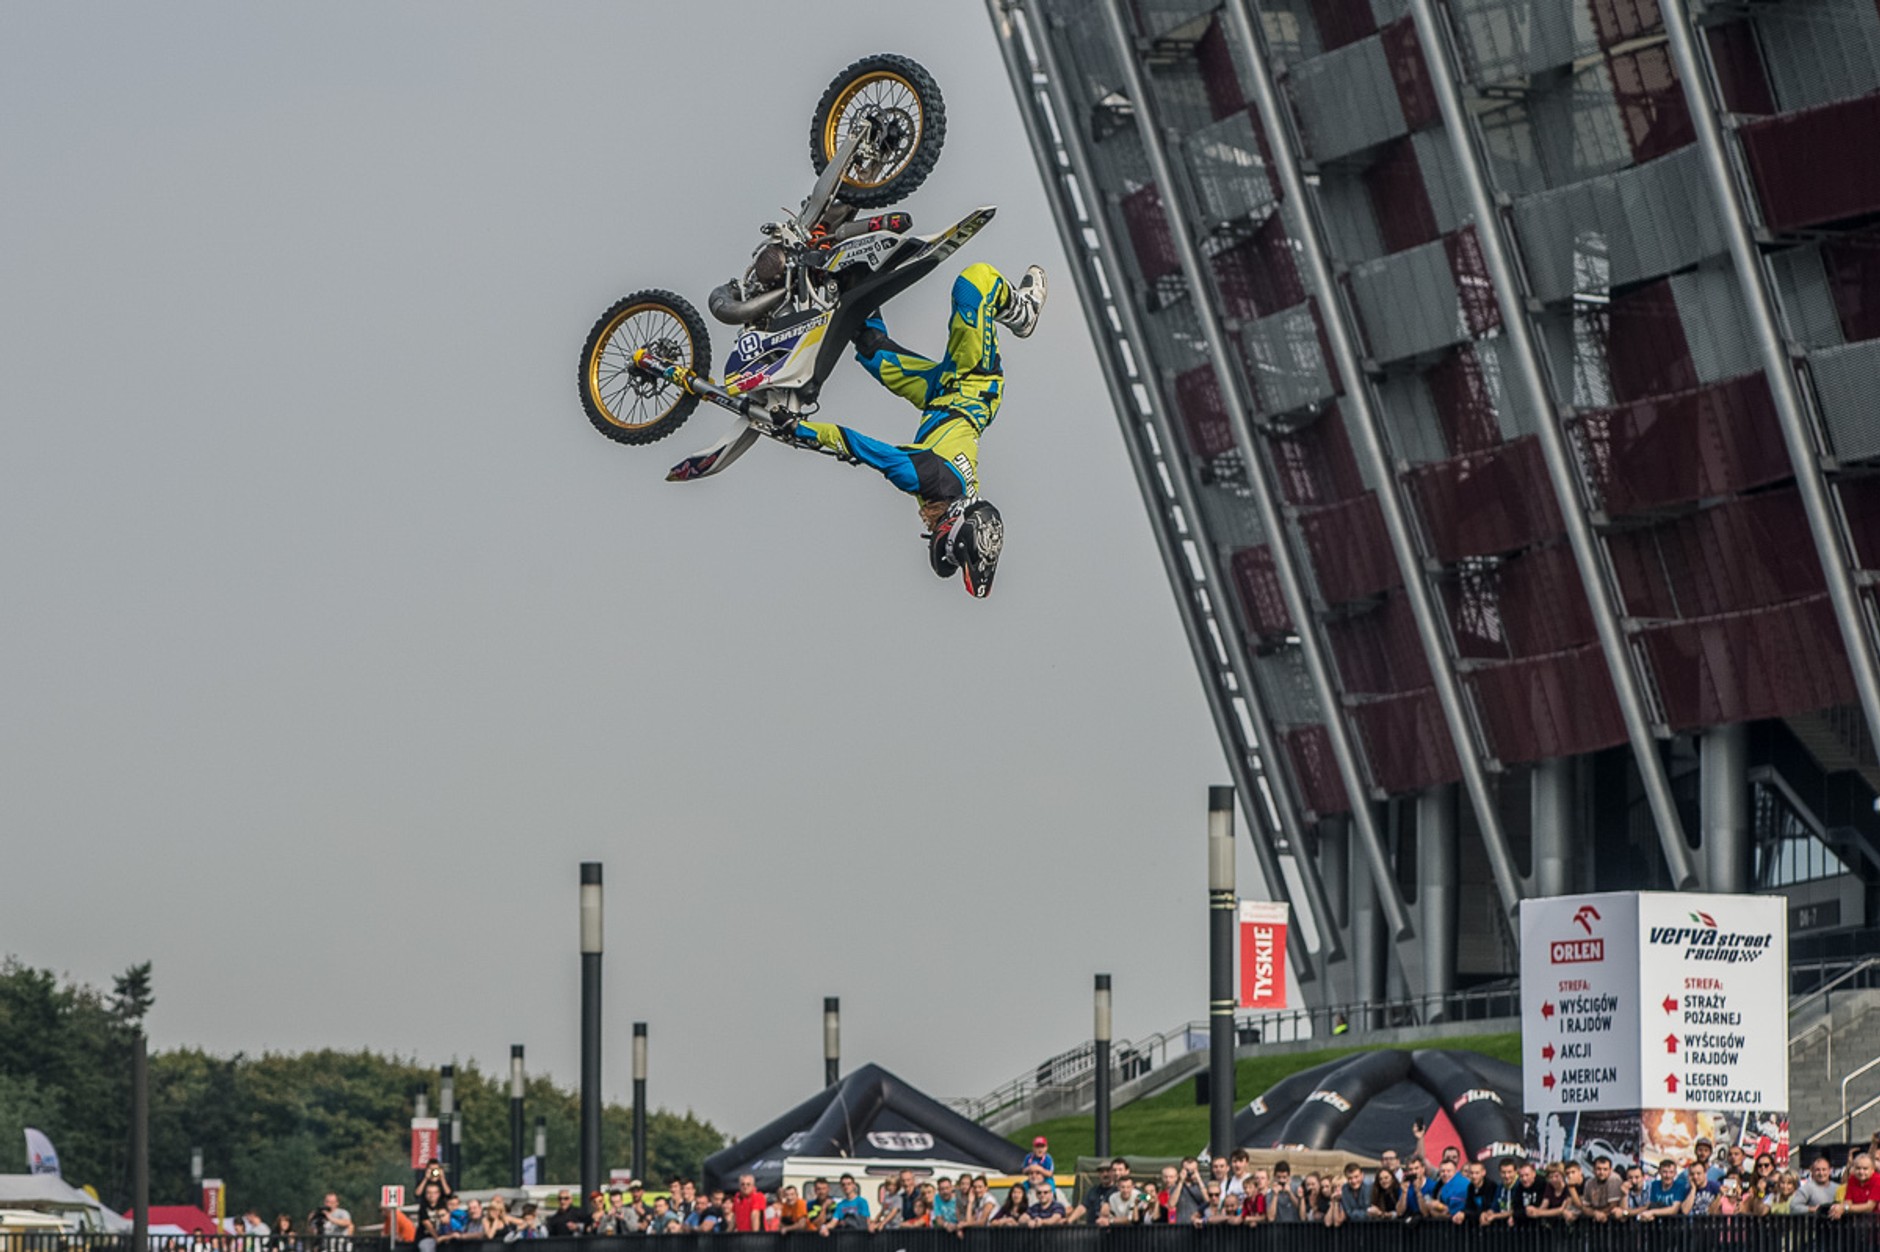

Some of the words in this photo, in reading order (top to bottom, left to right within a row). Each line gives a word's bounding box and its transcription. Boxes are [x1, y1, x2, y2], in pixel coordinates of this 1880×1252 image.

[1649, 927, 1718, 946] verva
[1717, 932, 1772, 948] street
[1552, 942, 1601, 962] ORLEN
[1684, 946, 1739, 964] racing
[1253, 926, 1273, 1001] TYSKIE
[1559, 980, 1591, 992] STREFA:
[1684, 977, 1724, 991] STREFA:
[1559, 993, 1618, 1015] WYŚCIGÓW
[1684, 993, 1727, 1009] STRAŻY
[1560, 1018, 1564, 1034] I
[1567, 1013, 1612, 1034] RAJDÓW
[1684, 1008, 1742, 1025] POŻARNEJ
[1684, 1032, 1745, 1048] WYŚCIGÓW
[1560, 1042, 1592, 1059] AKCJI
[1685, 1051, 1689, 1064] I
[1692, 1049, 1739, 1065] RAJDÓW
[1560, 1066, 1617, 1085] AMERICAN
[1685, 1073, 1728, 1087] LEGEND
[1562, 1087, 1599, 1104] DREAM
[1685, 1090, 1761, 1104] MOTORYZACJI
